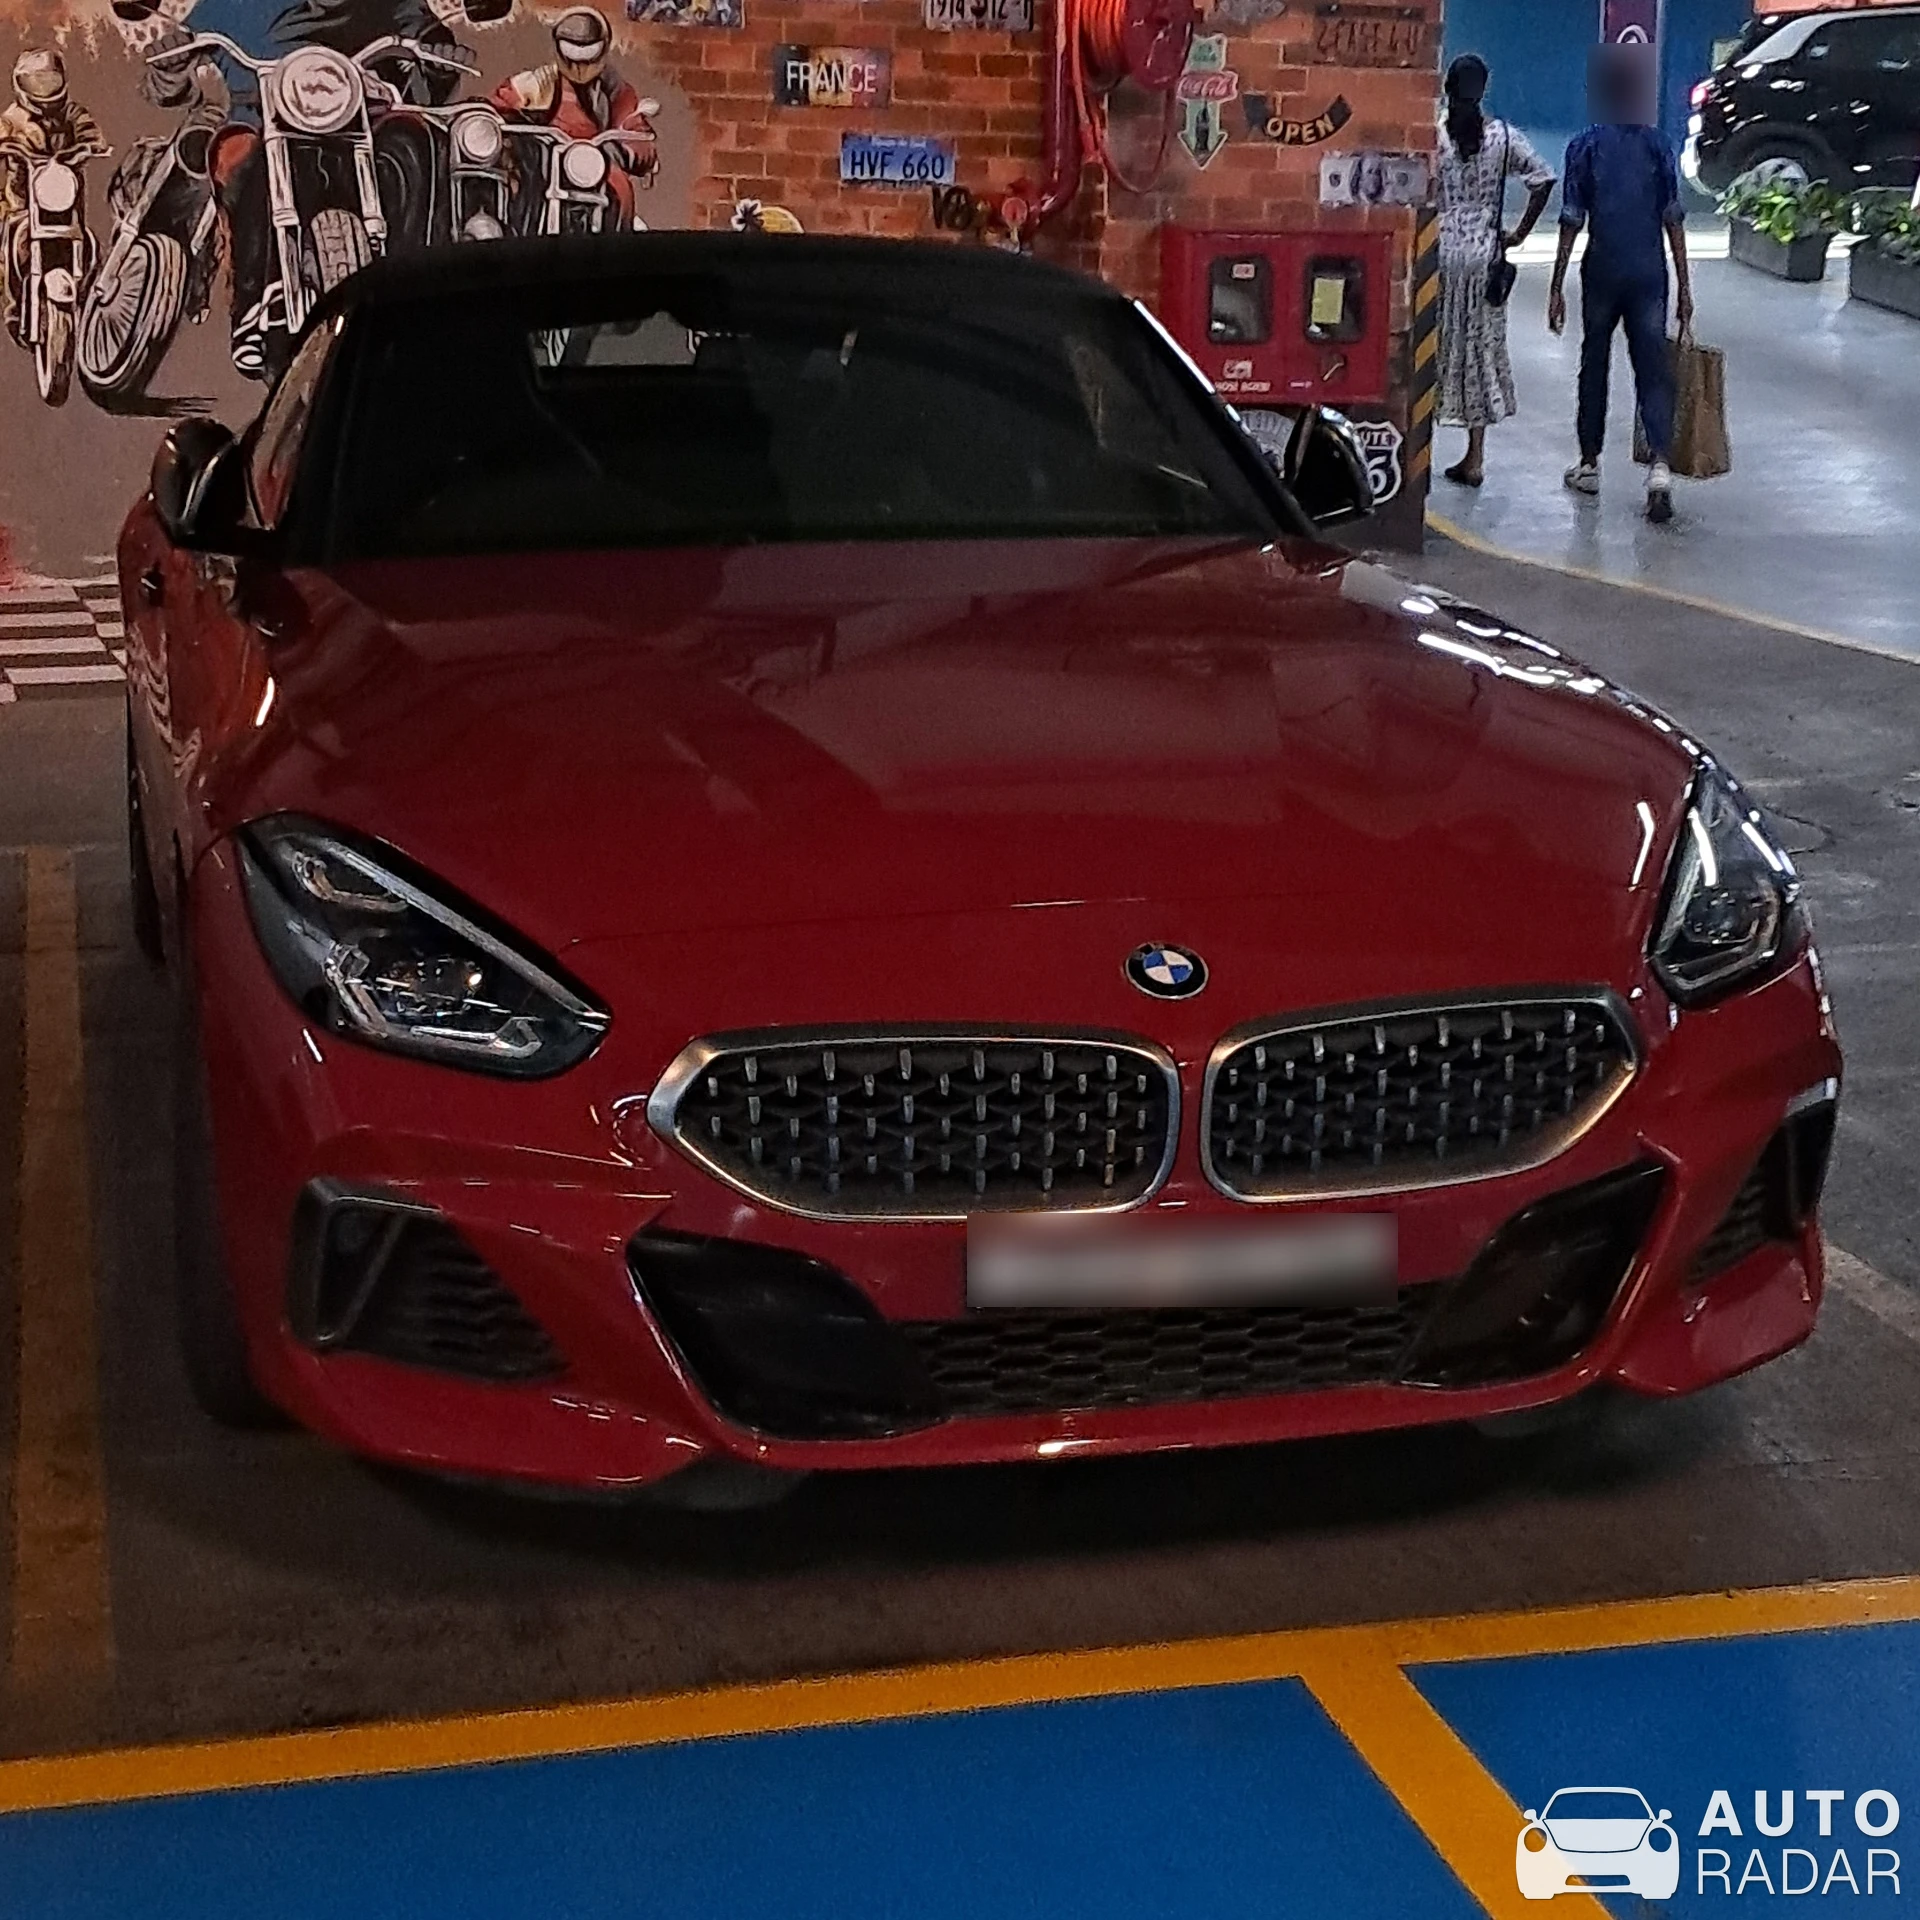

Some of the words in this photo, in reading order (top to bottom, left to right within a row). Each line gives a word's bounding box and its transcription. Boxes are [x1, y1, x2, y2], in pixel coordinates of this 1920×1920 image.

[785, 60, 878, 93] FRANCE
[1266, 116, 1336, 143] OPEN
[850, 150, 894, 177] HVF
[902, 152, 945, 179] 660
[1367, 455, 1387, 495] 6
